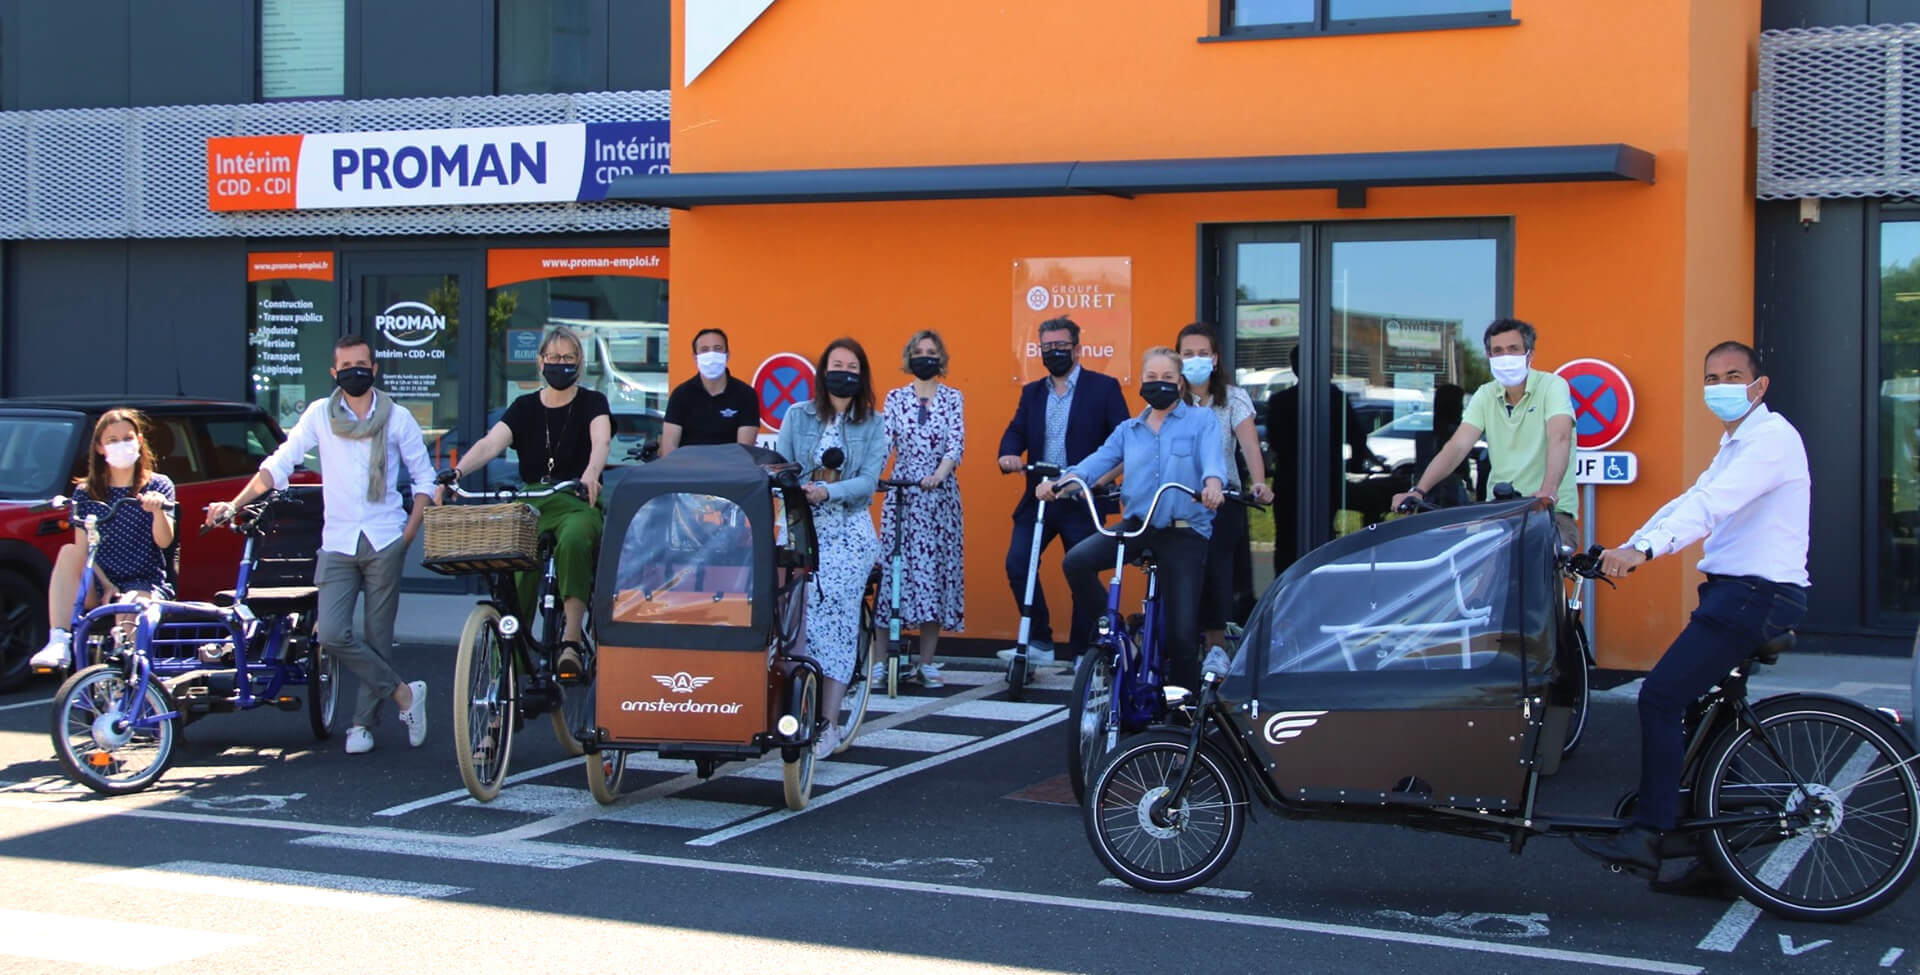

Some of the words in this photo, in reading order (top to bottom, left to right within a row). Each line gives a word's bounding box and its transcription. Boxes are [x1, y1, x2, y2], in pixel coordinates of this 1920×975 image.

[215, 152, 291, 176] Intérim
[332, 141, 547, 192] PROMAN
[216, 178, 251, 196] CDD
[264, 177, 291, 195] CDI
[254, 262, 329, 272] www.proman-emploi.fr
[541, 256, 660, 270] www.proman-emploi.fr
[1052, 285, 1099, 293] GROUPE
[263, 299, 313, 309] Construction
[1052, 293, 1116, 308] DURET
[263, 312, 293, 322] Travaux
[295, 312, 323, 323] publics
[375, 315, 446, 330] PROMAN
[263, 326, 298, 335] Industrie
[263, 339, 295, 348] Tertiaire
[375, 349, 403, 358] Intérim
[408, 349, 425, 358] CDD
[431, 349, 445, 358] CDI
[1026, 342, 1114, 357] Binue
[262, 352, 300, 362] Transport
[262, 365, 303, 375] Logistique
[620, 697, 718, 713] amsterdam
[719, 702, 744, 714] air
